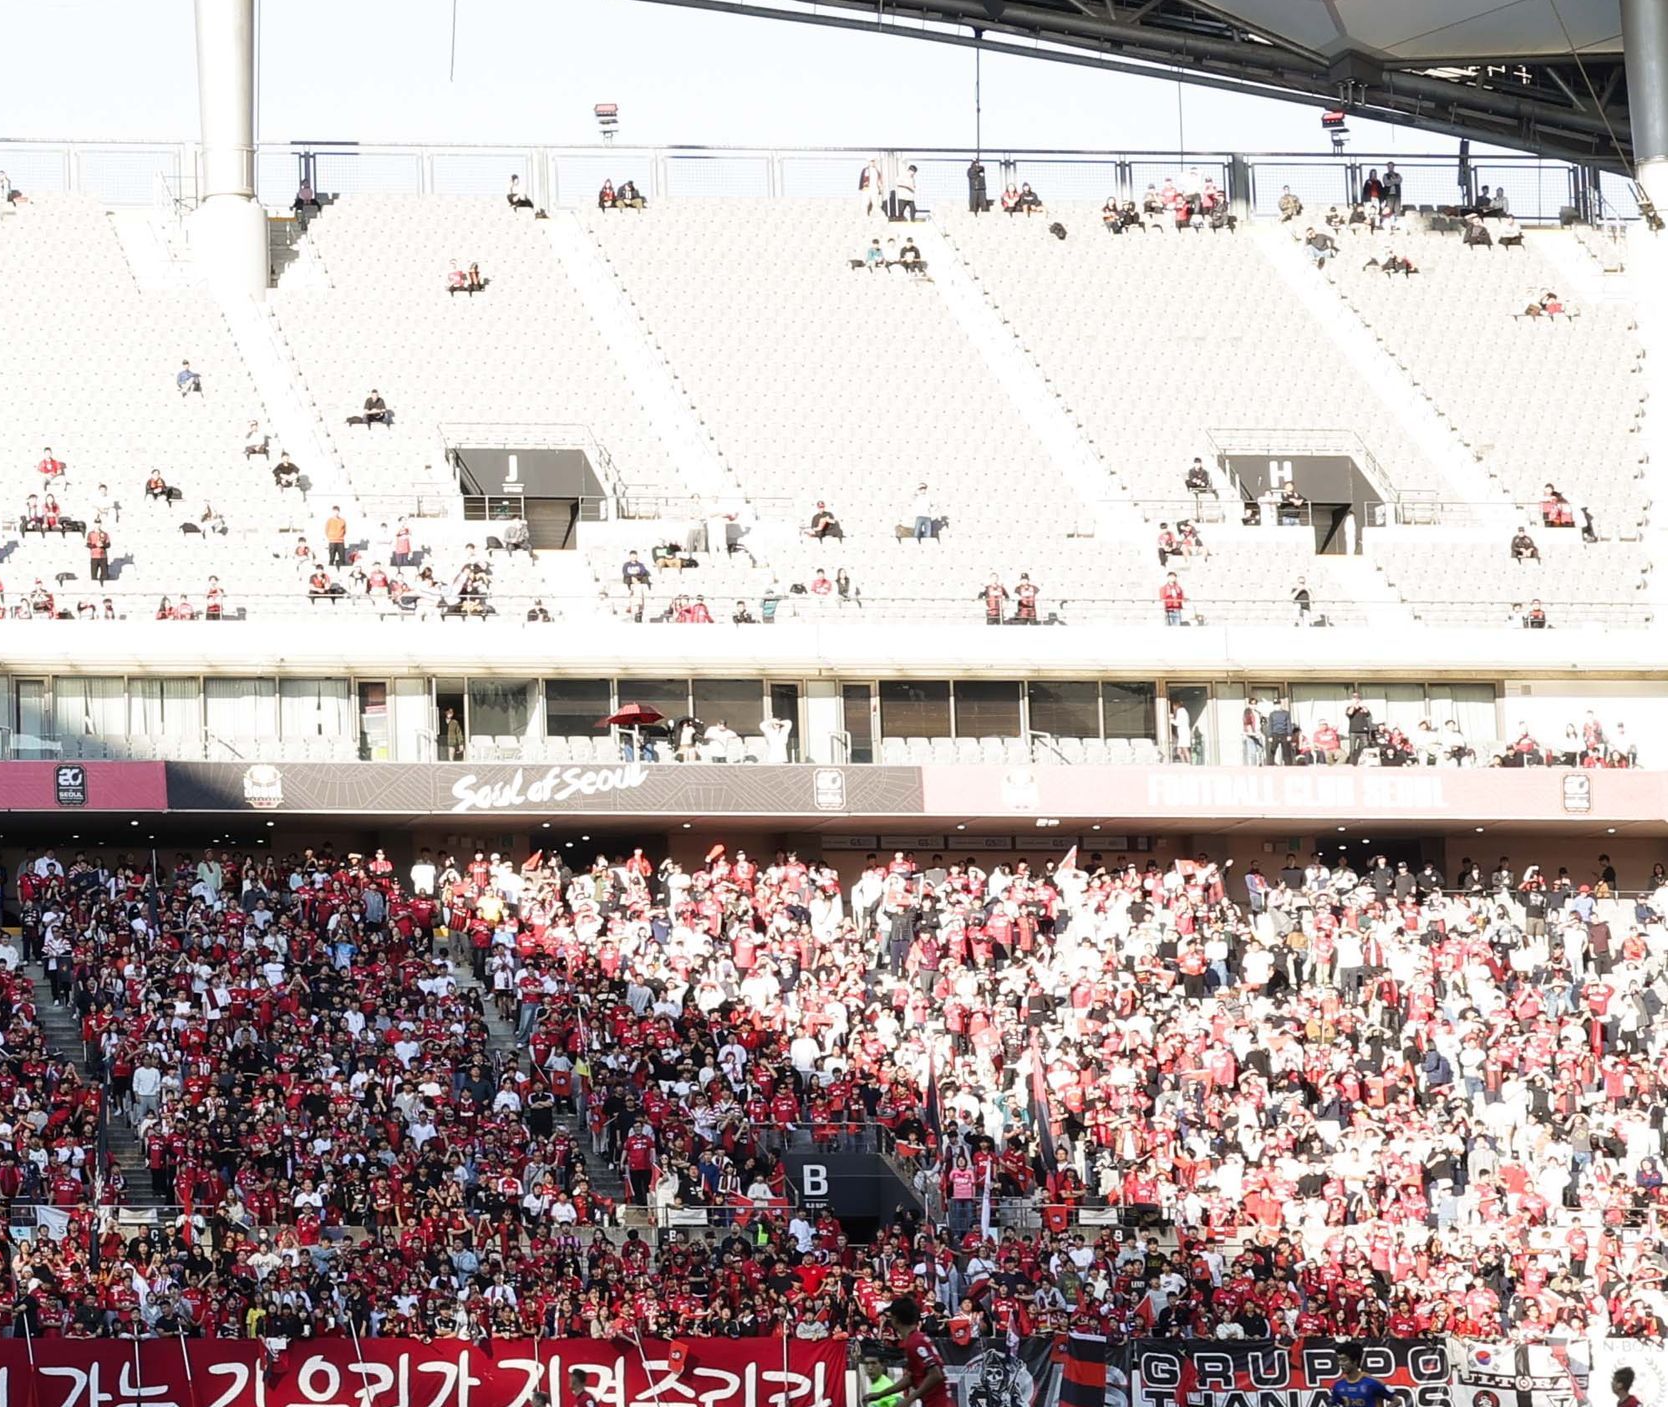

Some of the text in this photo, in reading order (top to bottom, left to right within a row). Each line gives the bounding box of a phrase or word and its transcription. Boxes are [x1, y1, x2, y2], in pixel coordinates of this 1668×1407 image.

[505, 454, 519, 483] J
[1269, 460, 1294, 488] H
[451, 762, 649, 811] Soul of Seoul
[802, 1164, 829, 1197] B
[150, 1229, 159, 1241] C
[1140, 1344, 1451, 1390] GRUPPO
